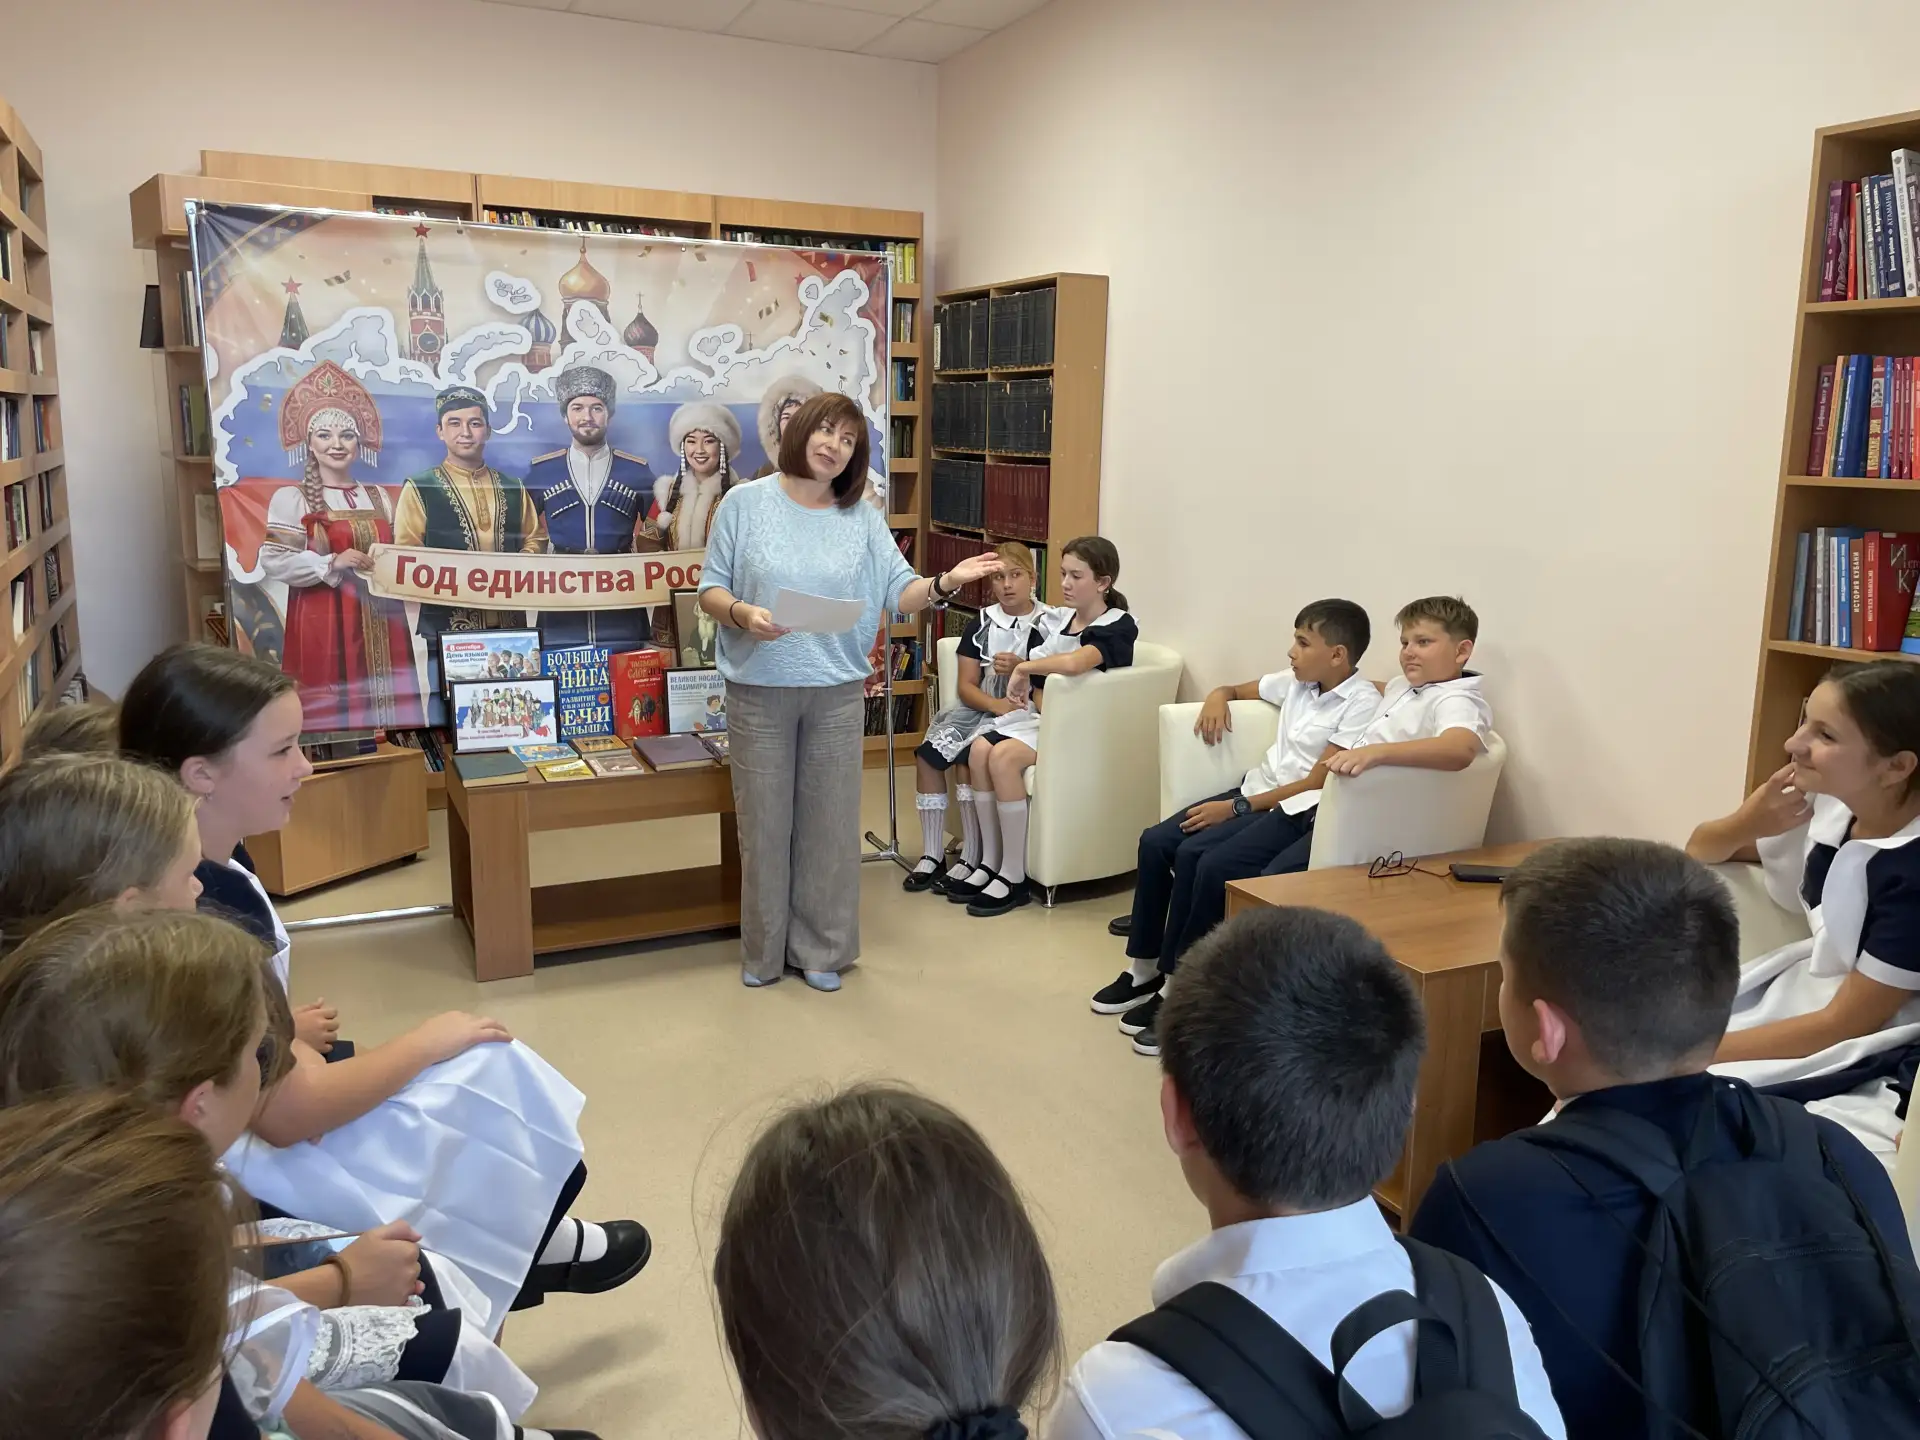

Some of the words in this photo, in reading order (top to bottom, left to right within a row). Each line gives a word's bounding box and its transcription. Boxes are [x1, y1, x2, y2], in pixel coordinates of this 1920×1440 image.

[1886, 191, 1894, 226] АТАМАНЫ
[396, 555, 459, 597] Год
[467, 567, 634, 599] единства
[547, 649, 608, 666] БОЛЬШАЯ
[562, 695, 596, 704] РАЗВИТИЕ
[562, 706, 611, 726] ЕЧИ
[560, 723, 610, 736] АЛЫША
